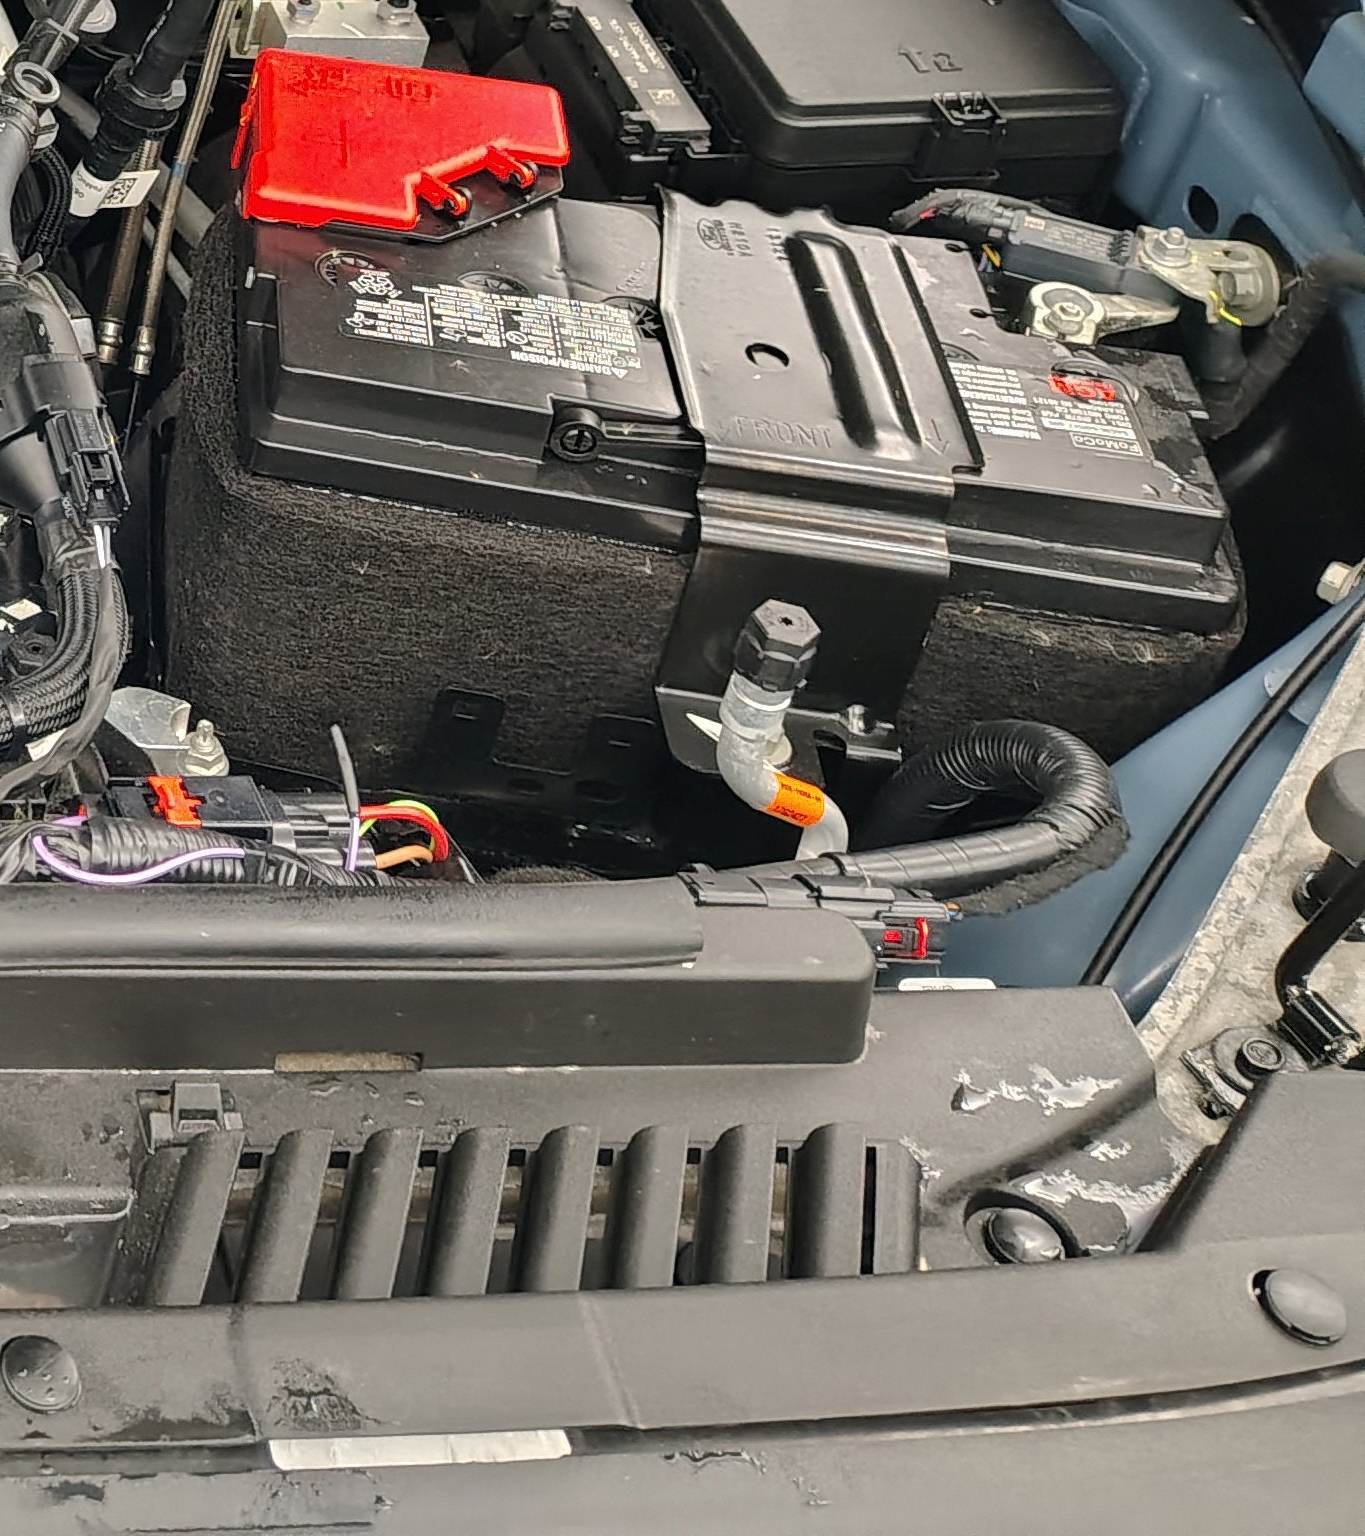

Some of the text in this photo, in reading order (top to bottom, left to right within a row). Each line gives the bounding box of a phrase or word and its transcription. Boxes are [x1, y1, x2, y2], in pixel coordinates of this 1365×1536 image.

[511, 350, 613, 375] DANGER/POISON
[734, 415, 833, 449] FRONT
[1074, 435, 1139, 453] FoMoCo
